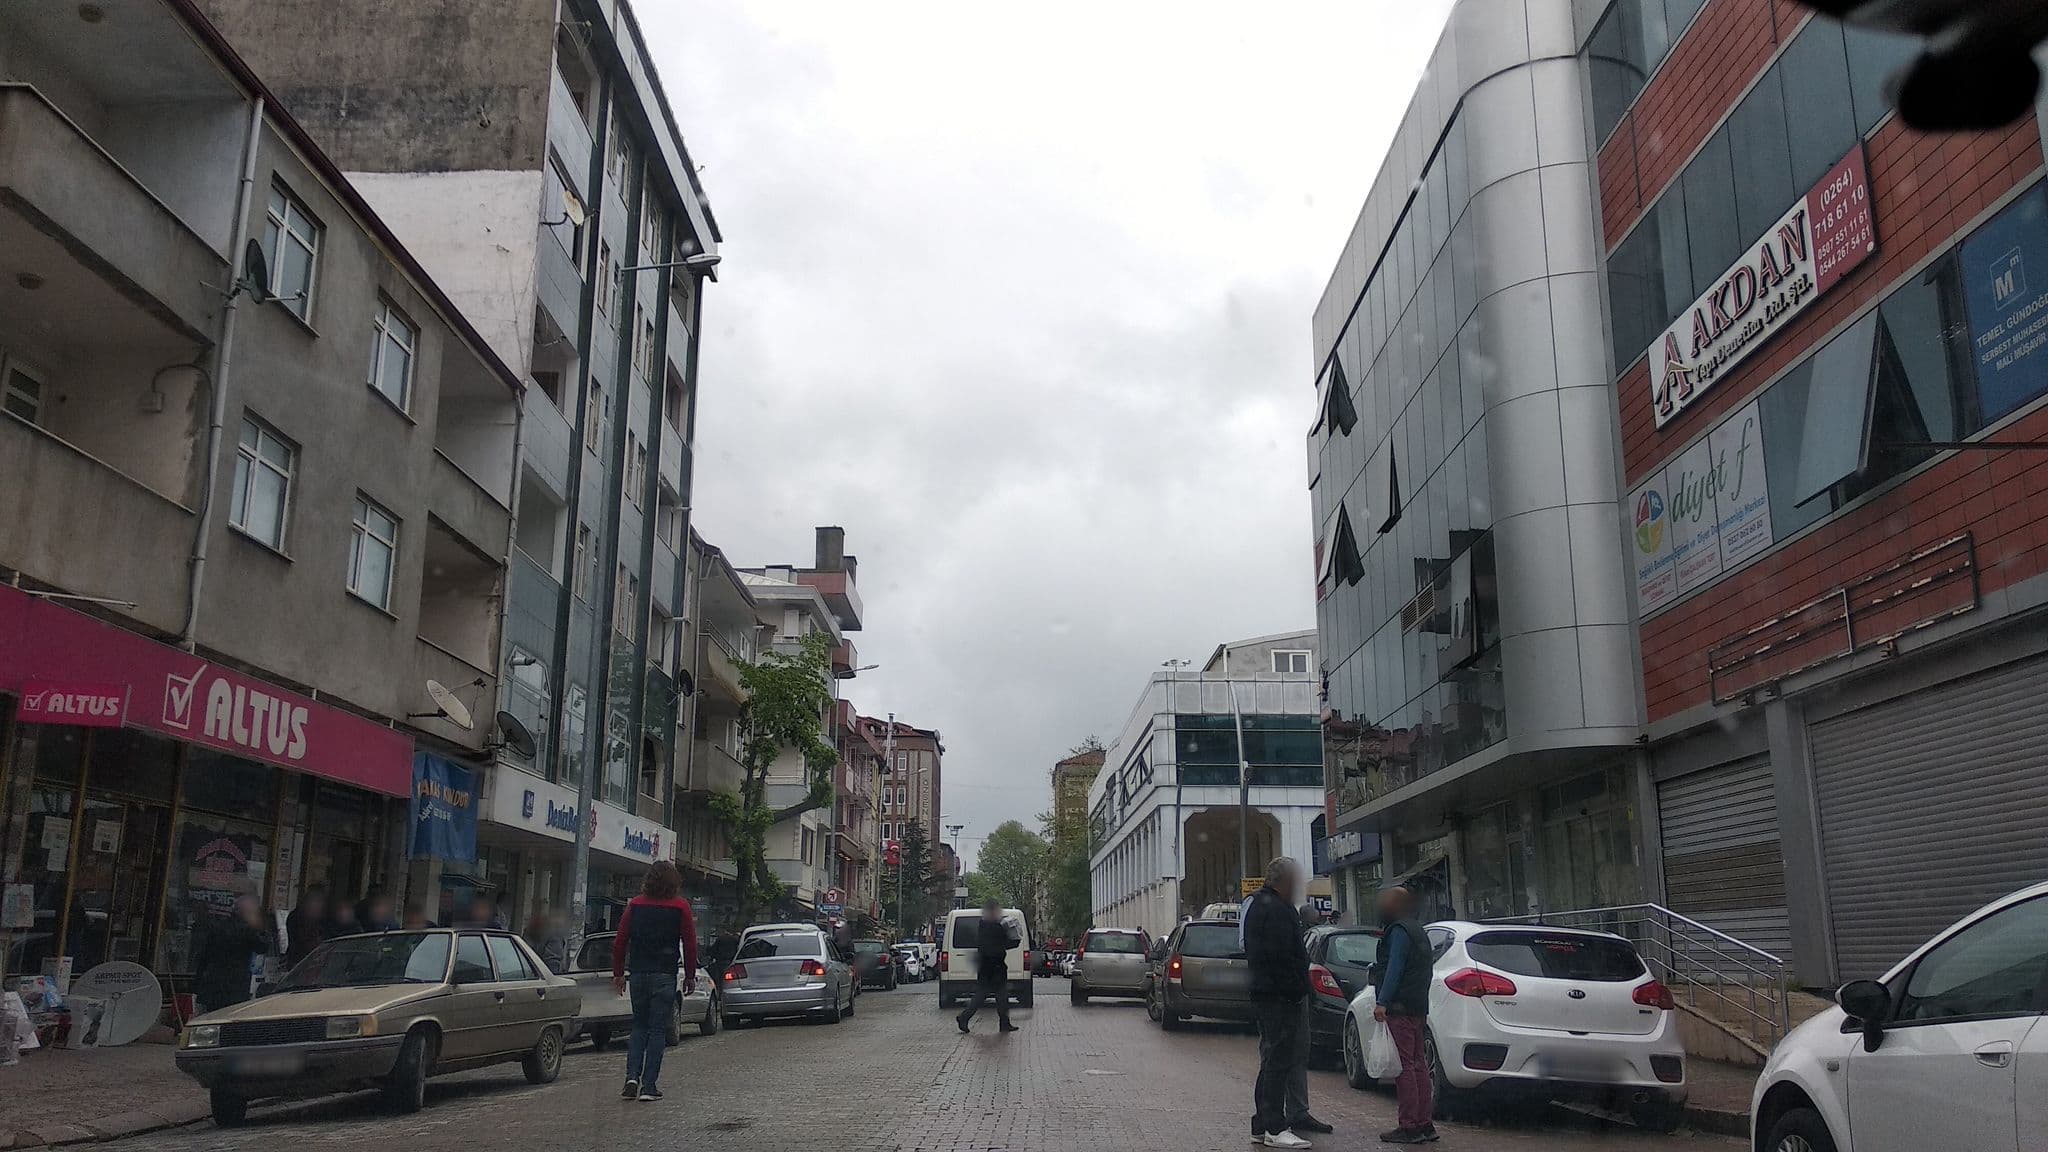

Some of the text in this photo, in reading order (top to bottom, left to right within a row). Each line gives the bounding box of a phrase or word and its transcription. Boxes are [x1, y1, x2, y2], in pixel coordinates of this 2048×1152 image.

[1815, 184, 1864, 239] 718 61 10
[1821, 168, 1853, 211] (0264)
[1817, 208, 1868, 260] 0507 551 11 61
[1820, 224, 1870, 276] 0544 267 54 61
[1690, 210, 1808, 358] AKDAN
[1977, 327, 2005, 348] TEMEL
[1981, 339, 2011, 365] SERBEST
[1673, 417, 1752, 522] diyet f
[47, 692, 119, 716] ALTUS
[203, 678, 308, 760] ALTUS
[1570, 990, 1584, 998] KIA
